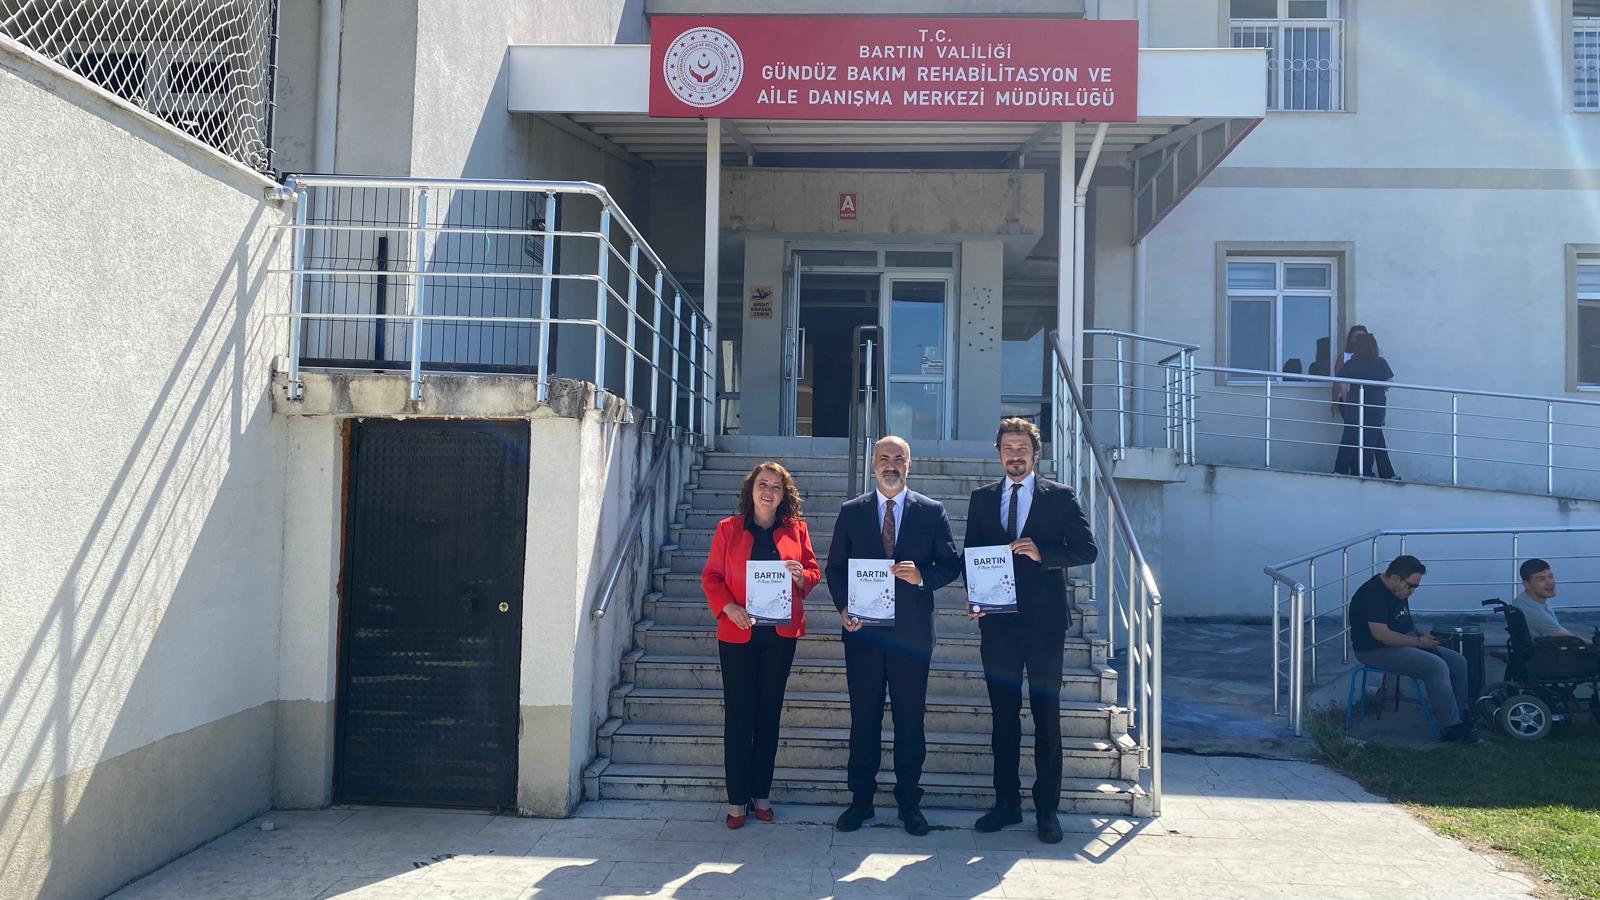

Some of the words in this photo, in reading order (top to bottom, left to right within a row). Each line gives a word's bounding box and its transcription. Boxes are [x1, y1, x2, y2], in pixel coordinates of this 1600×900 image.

[918, 29, 952, 43] T.C.
[859, 45, 924, 59] BARTIN
[936, 43, 1012, 59] VALİLİĞİ
[761, 61, 837, 81] GÜNDÜZ
[847, 66, 906, 81] BAKIM
[917, 63, 1078, 82] REHABİLİTASYON
[1088, 67, 1112, 82] VE
[757, 85, 798, 104] AİLE
[808, 89, 893, 107] DANIŞMA
[903, 87, 985, 106] MERKEZİ
[995, 87, 1115, 106] MÜDÜRLÜĞÜ
[841, 195, 855, 211] A
[973, 556, 1006, 566] BARTIN
[754, 571, 786, 579] BARTIN
[856, 570, 888, 578] BARTIN
